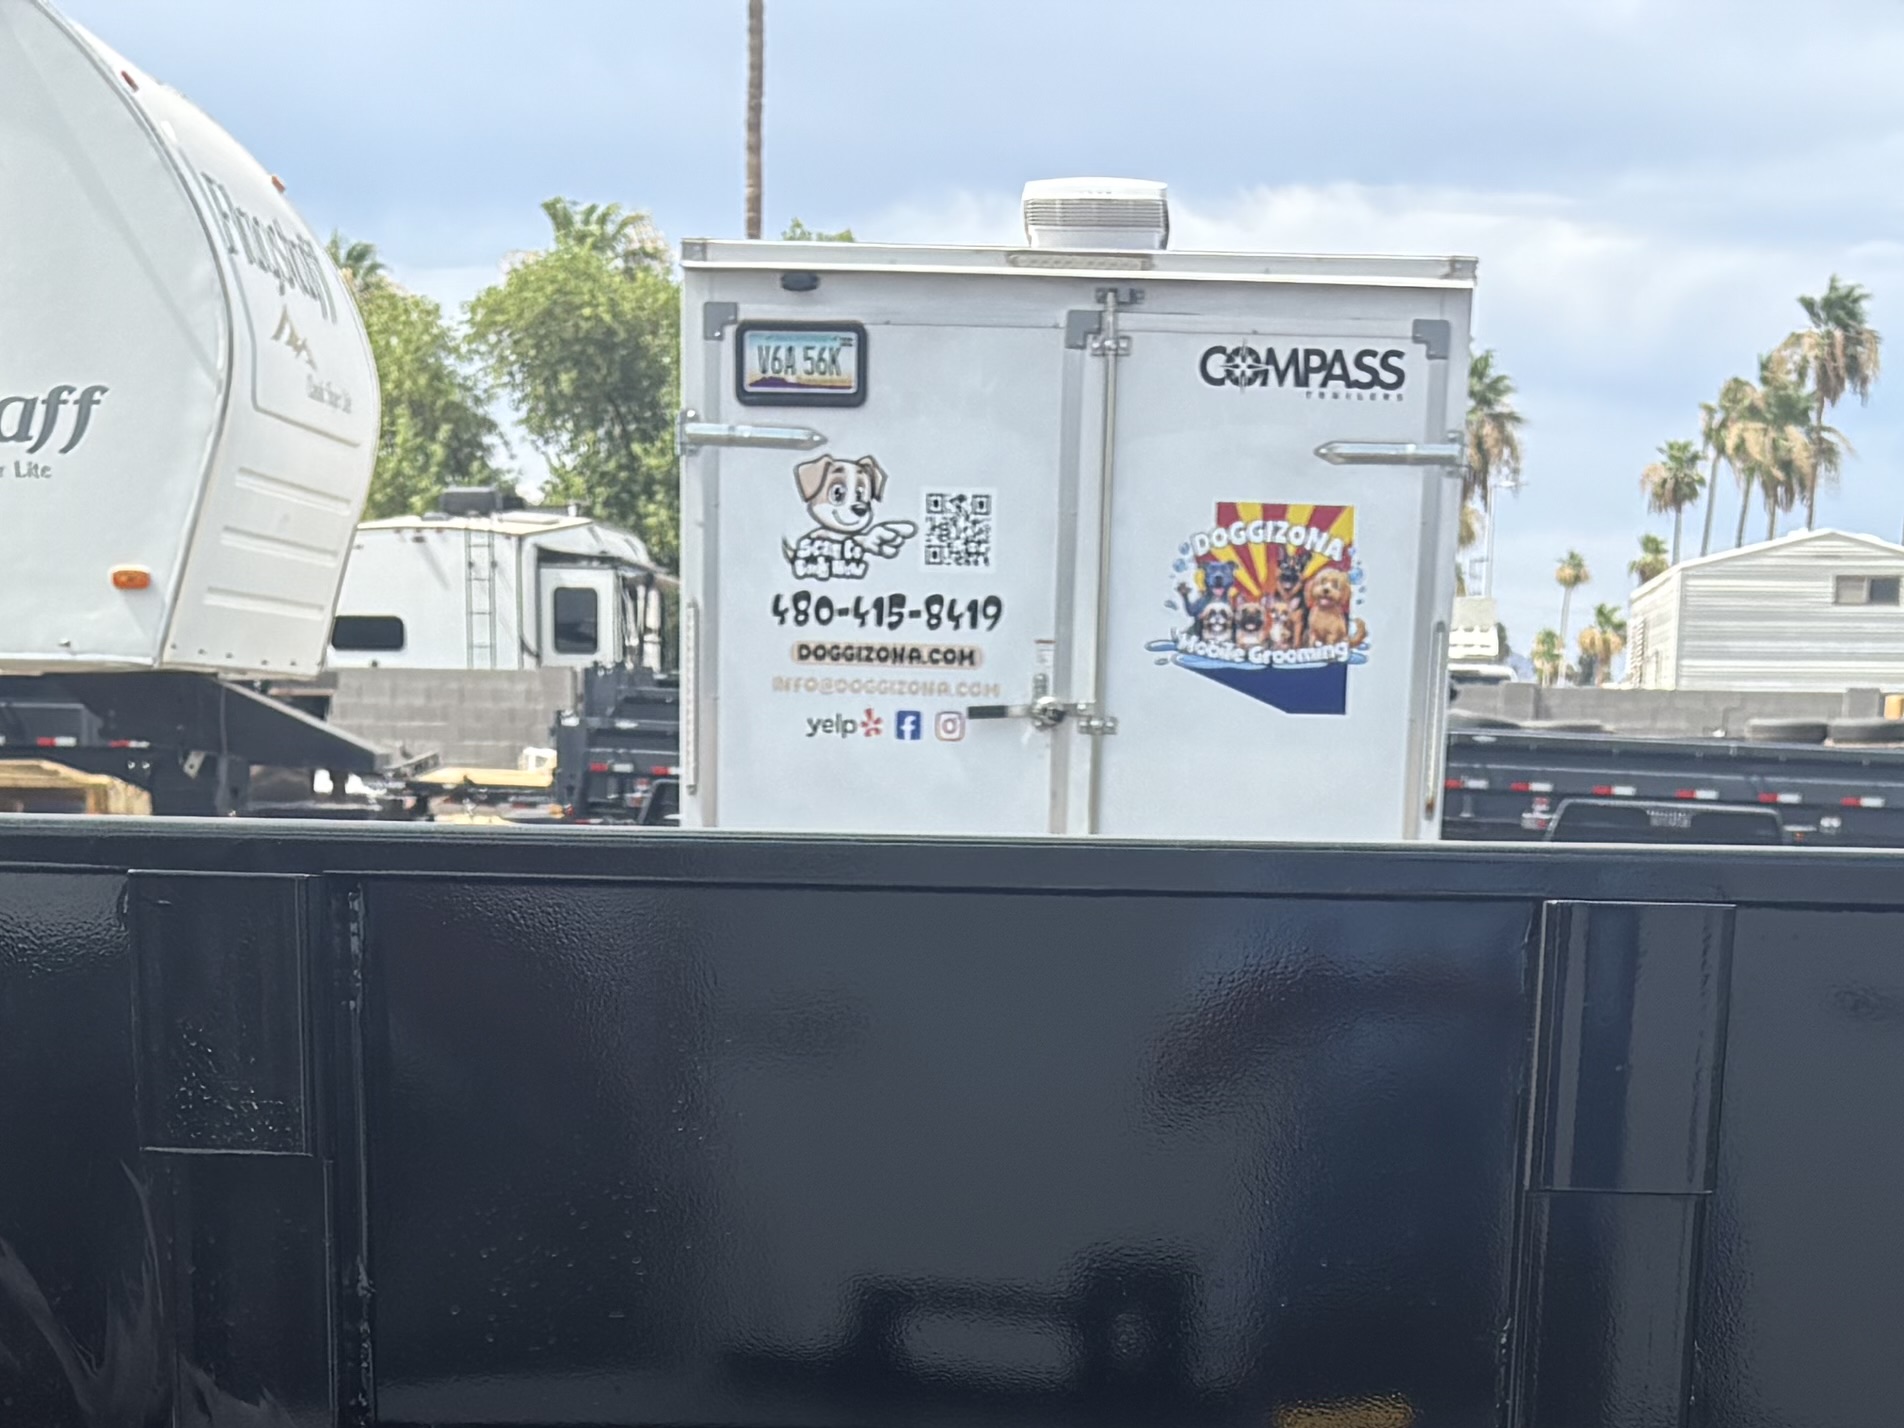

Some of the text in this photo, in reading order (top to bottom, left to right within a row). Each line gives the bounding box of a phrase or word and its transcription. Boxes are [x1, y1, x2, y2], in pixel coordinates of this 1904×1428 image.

[1200, 343, 1406, 391] COMPASS
[14, 461, 52, 479] Lite
[771, 590, 1003, 631] 480-415-8419
[806, 713, 857, 739] yelp
